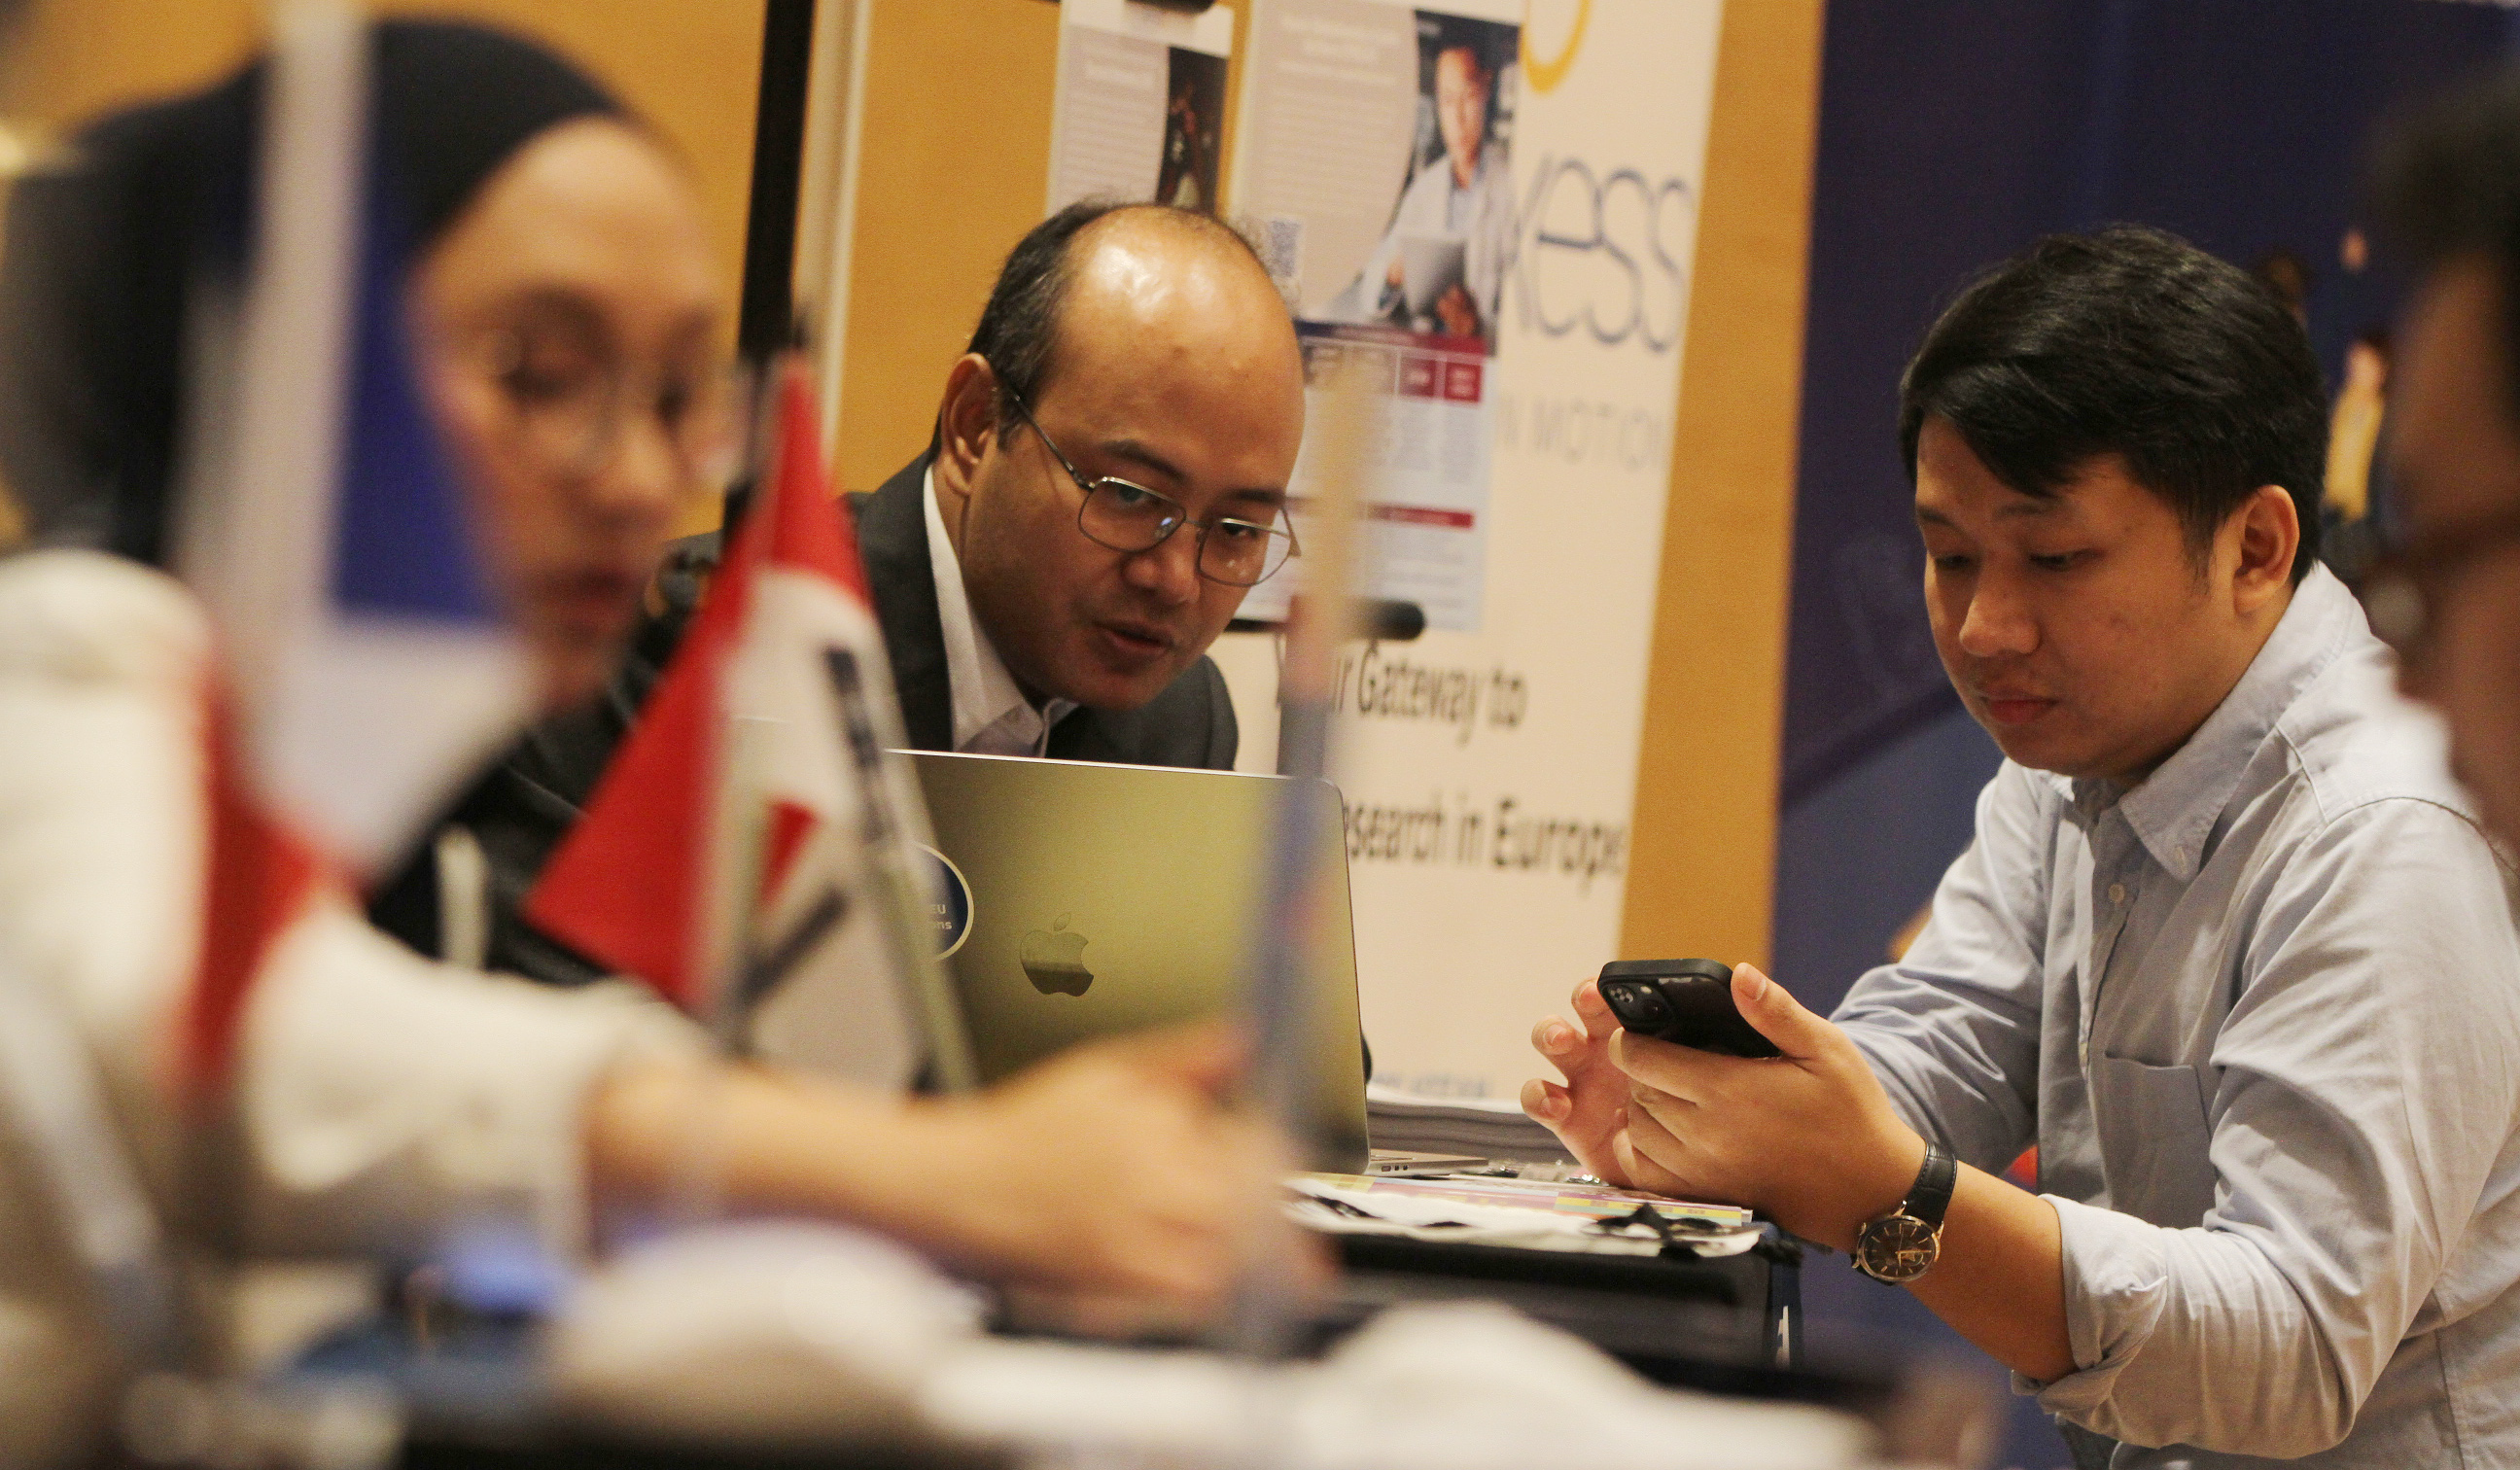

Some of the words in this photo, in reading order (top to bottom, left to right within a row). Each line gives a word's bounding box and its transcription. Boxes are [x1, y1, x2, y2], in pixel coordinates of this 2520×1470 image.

[1503, 153, 1696, 353] xess
[1357, 646, 1479, 748] Gateway
[1488, 669, 1528, 728] to
[1344, 789, 1445, 864] esearch
[1457, 791, 1484, 867] in
